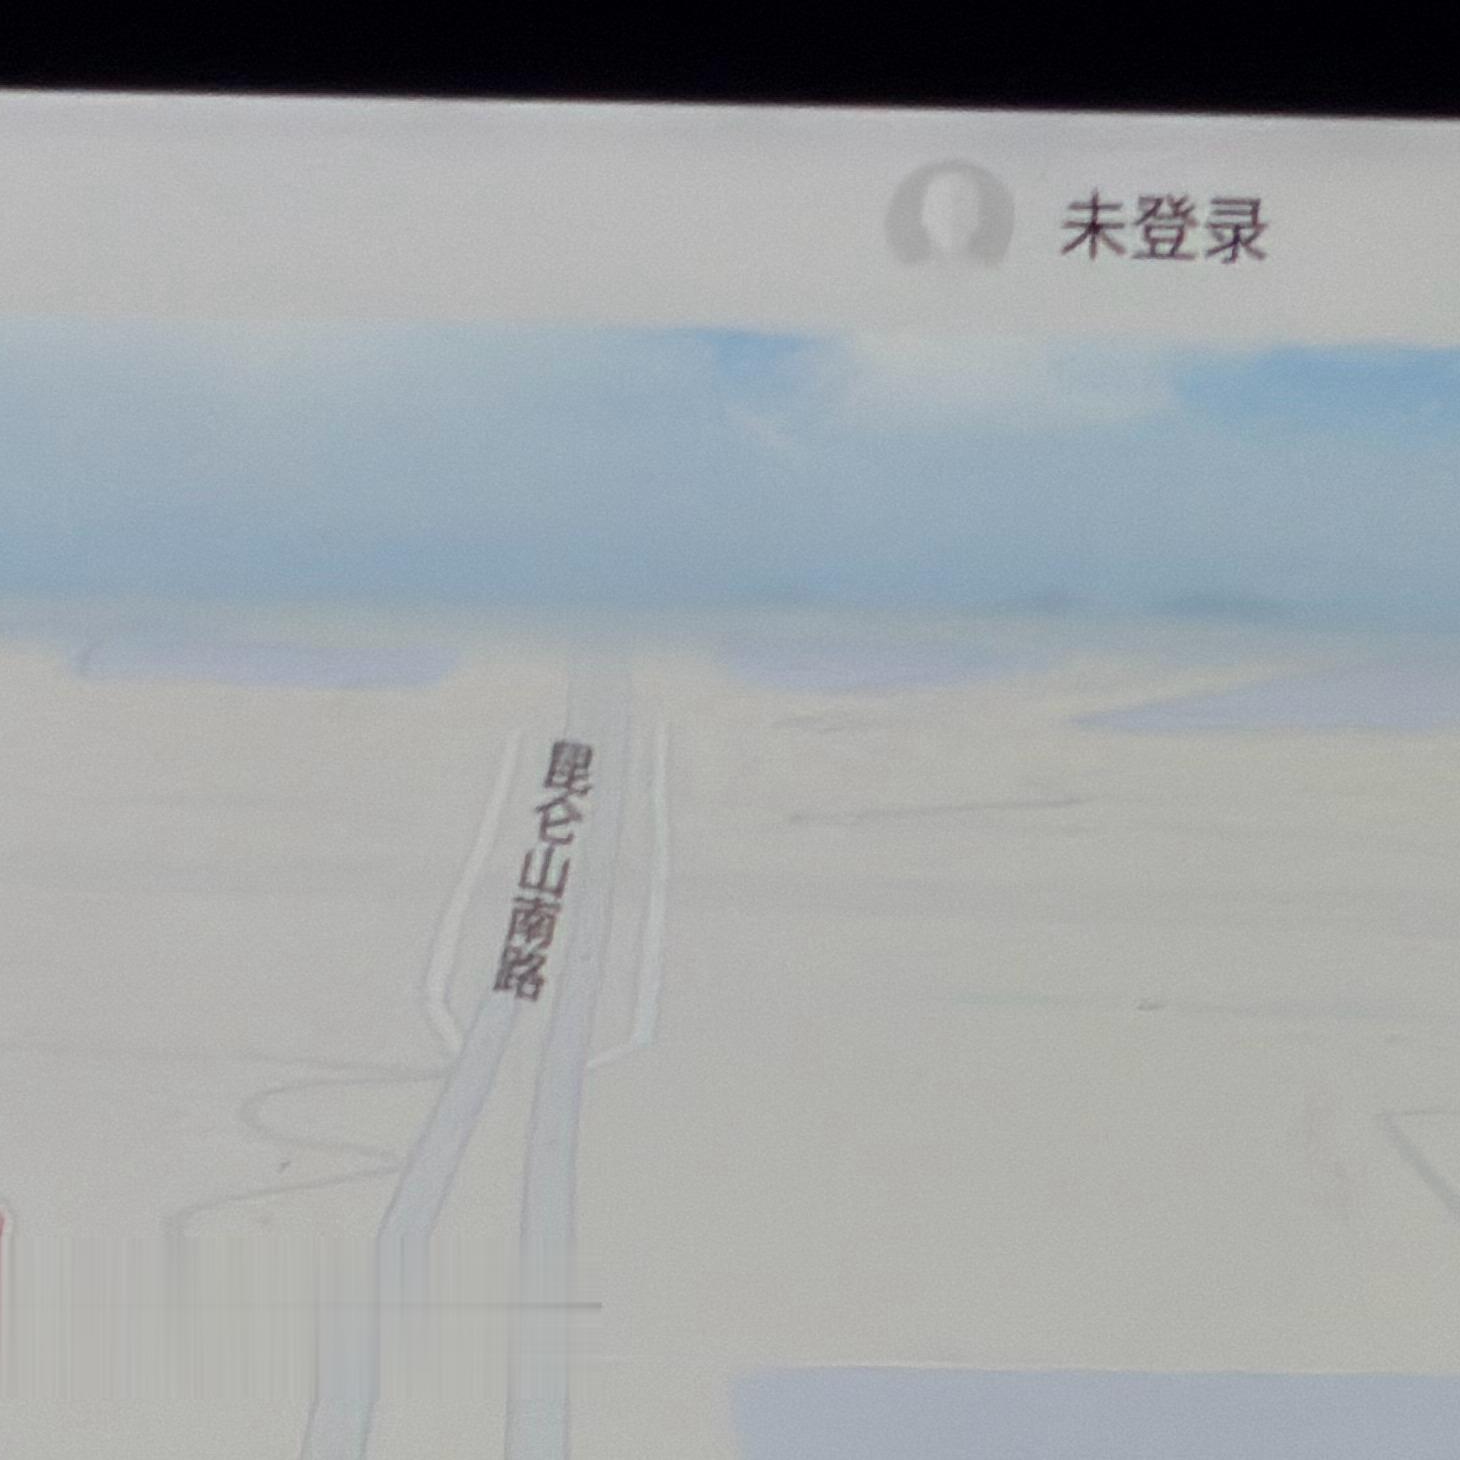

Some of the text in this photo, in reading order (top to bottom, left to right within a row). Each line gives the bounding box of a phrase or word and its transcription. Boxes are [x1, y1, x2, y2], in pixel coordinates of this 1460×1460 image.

[1061, 192, 1268, 264] 未登录
[492, 739, 594, 1003] 昆仑山南路
